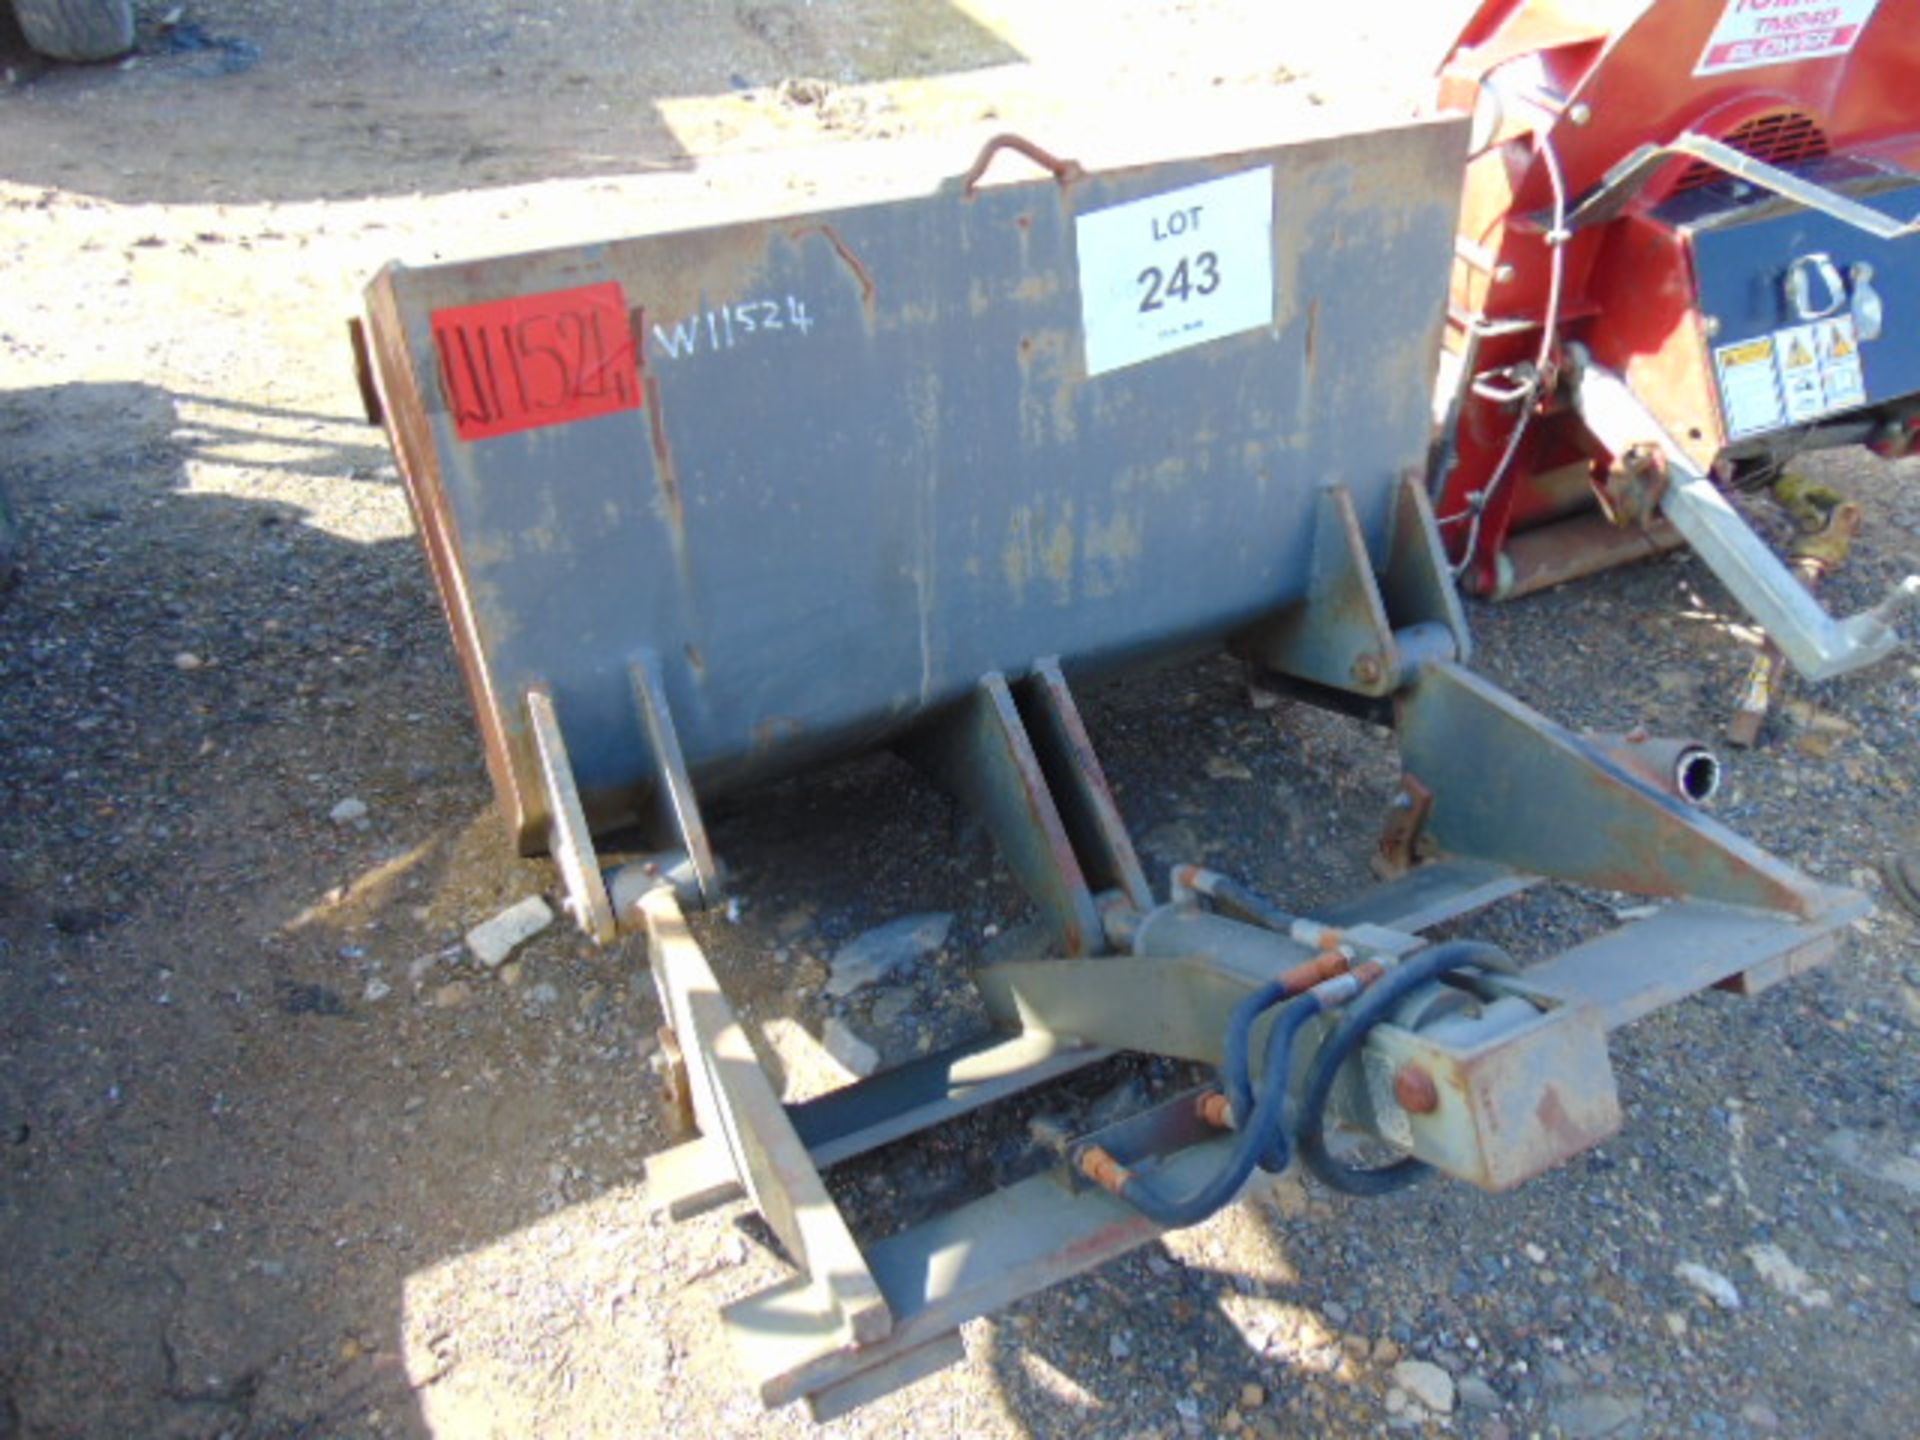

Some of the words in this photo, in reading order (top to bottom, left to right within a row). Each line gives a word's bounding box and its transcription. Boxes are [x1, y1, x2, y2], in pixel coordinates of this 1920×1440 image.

[1152, 205, 1204, 241] LOT
[1136, 250, 1221, 313] 243
[652, 296, 815, 359] W11524
